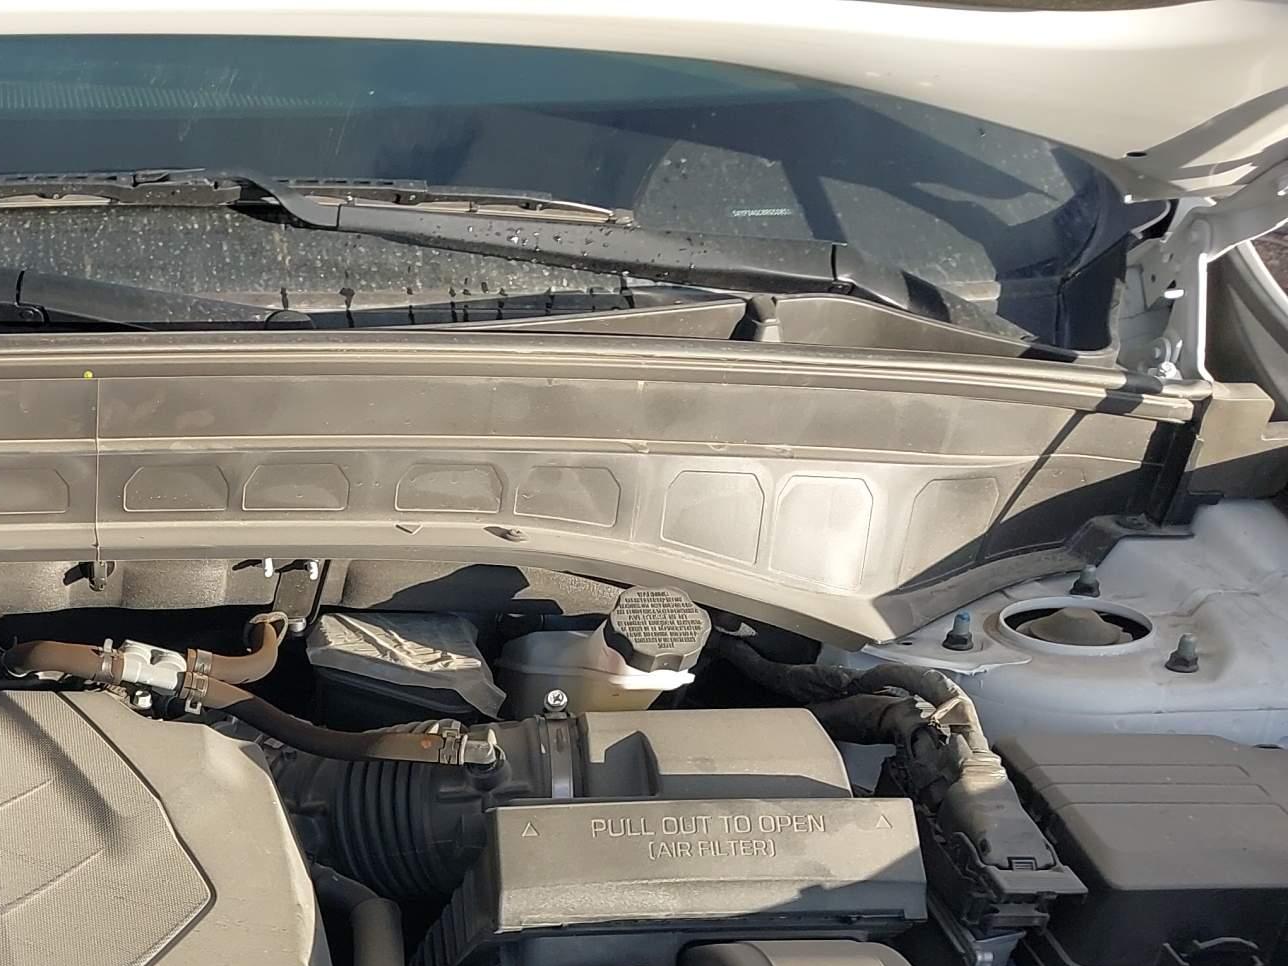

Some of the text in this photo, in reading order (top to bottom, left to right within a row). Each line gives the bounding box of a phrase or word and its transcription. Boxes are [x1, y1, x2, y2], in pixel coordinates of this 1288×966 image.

[591, 814, 826, 838] PULL OUT TO OPEN
[648, 839, 777, 861] (AIR FILTER)
